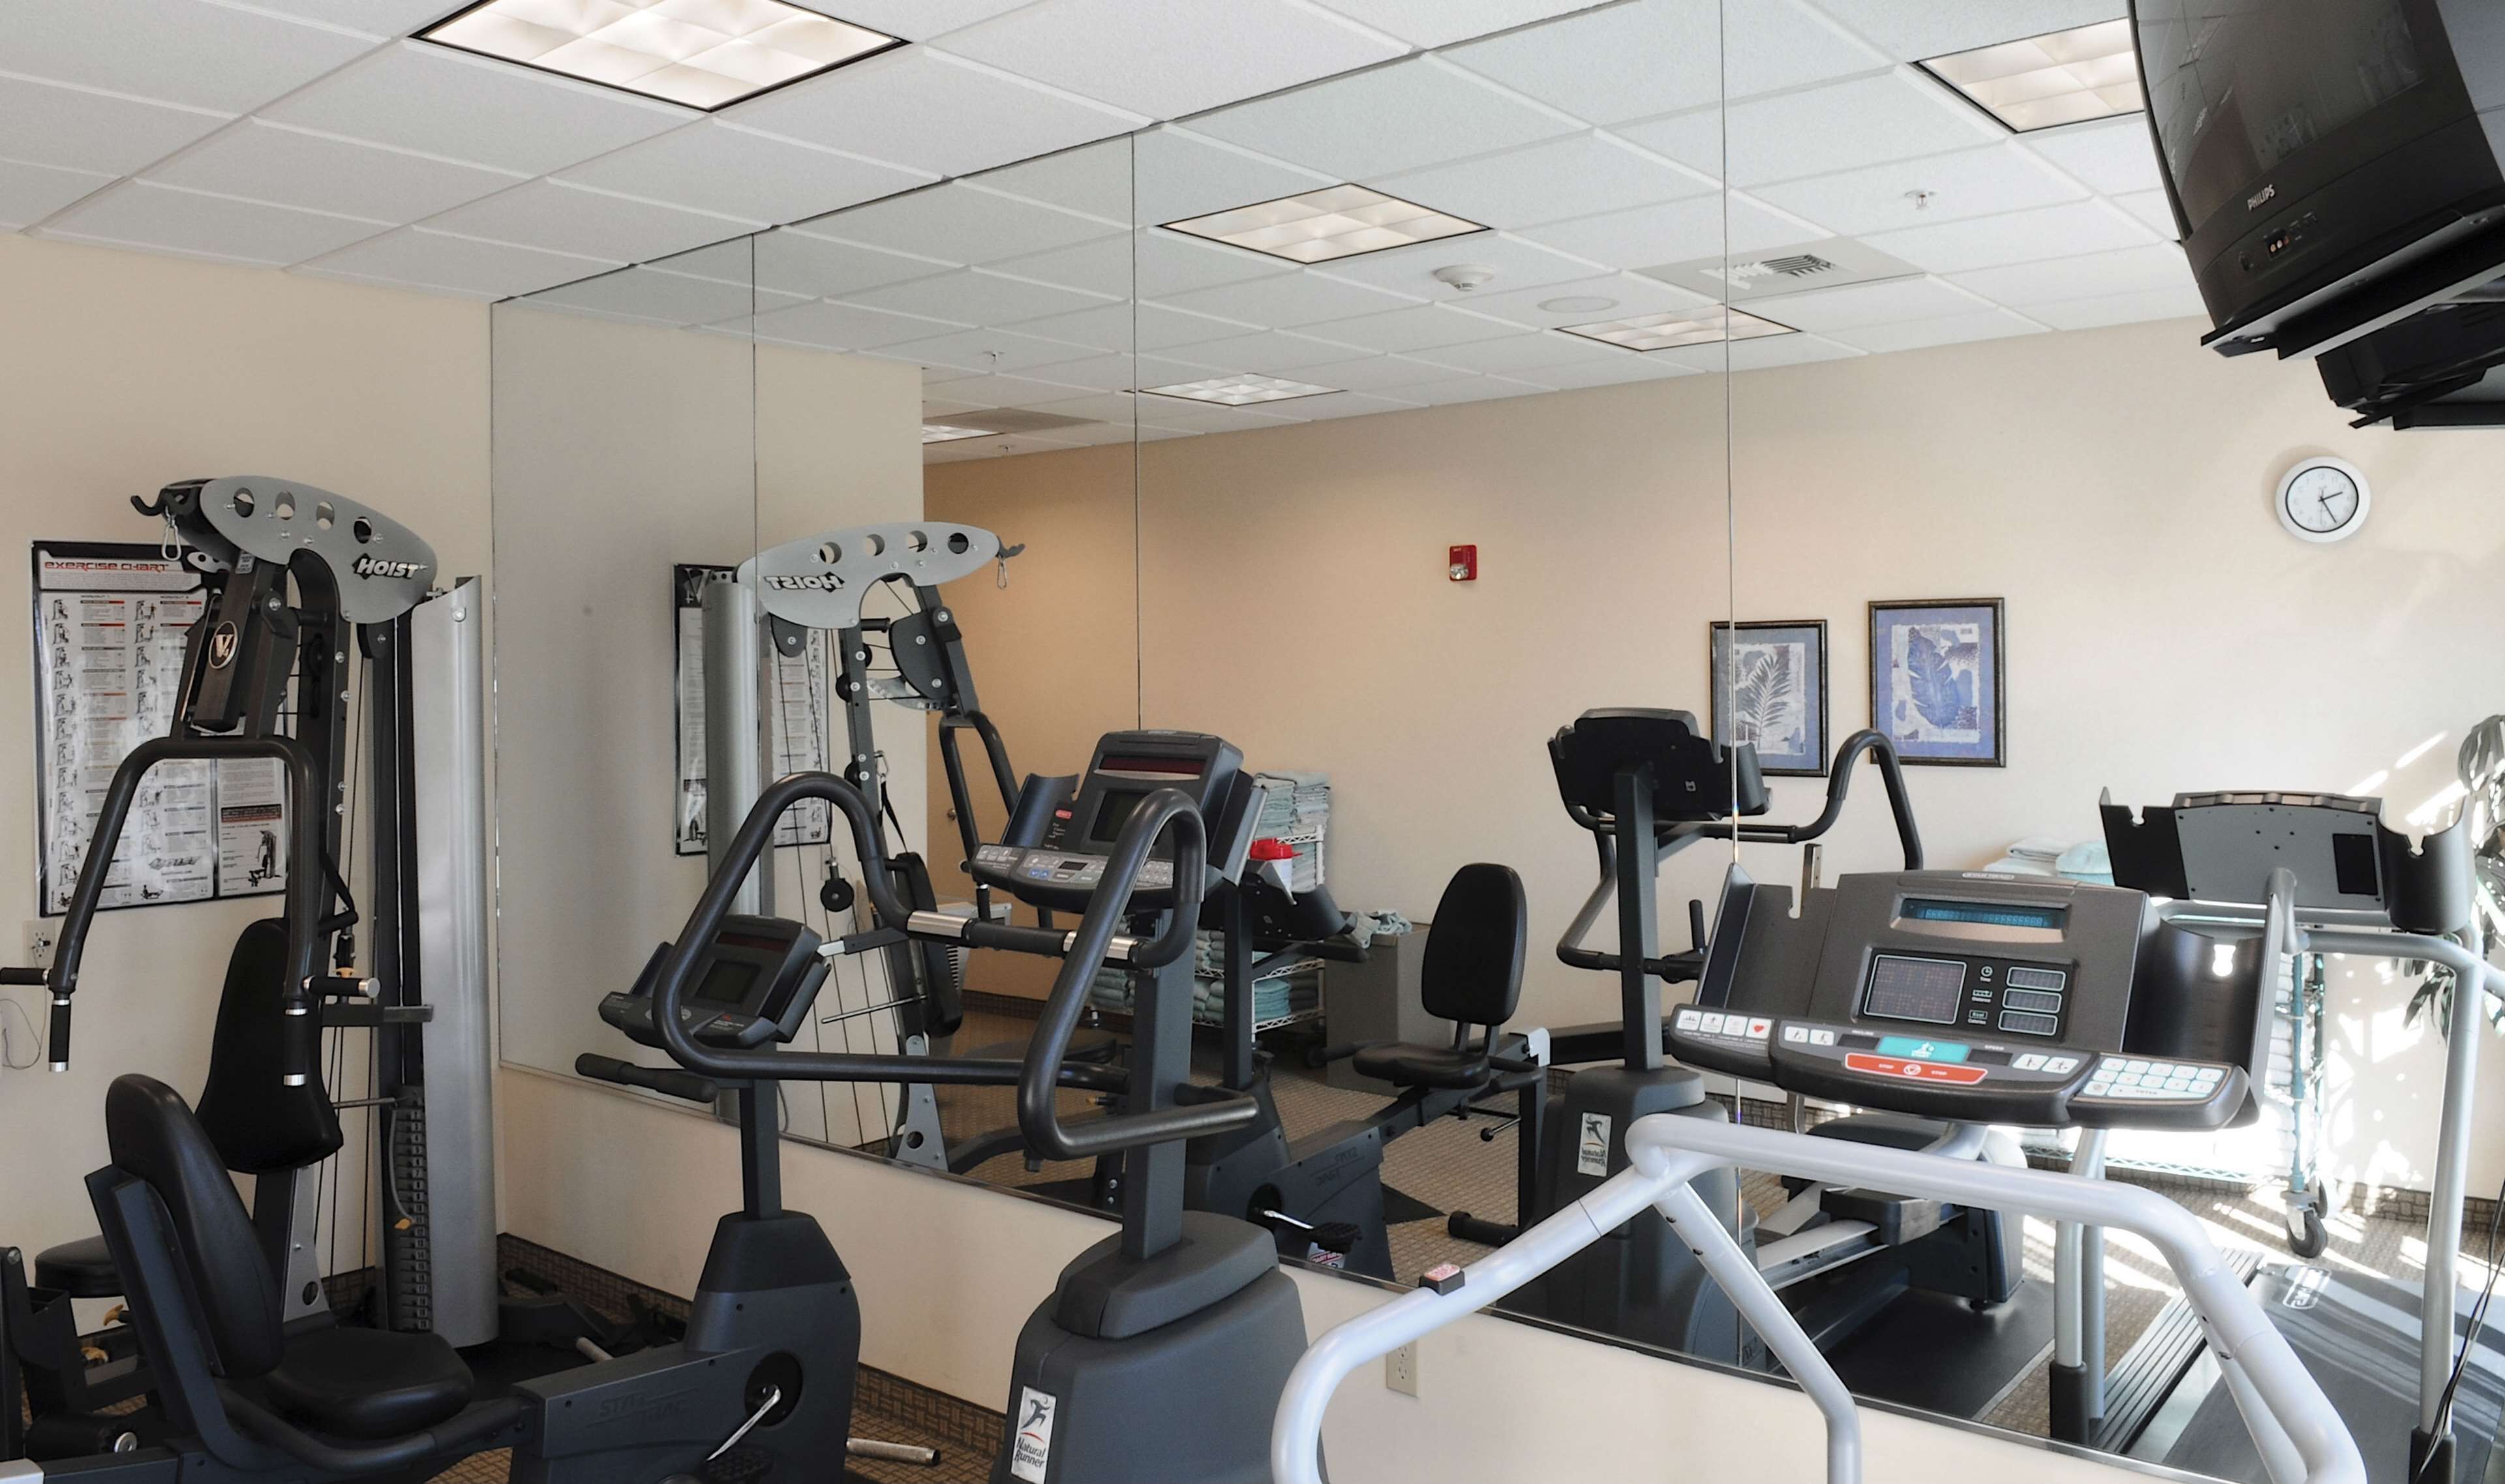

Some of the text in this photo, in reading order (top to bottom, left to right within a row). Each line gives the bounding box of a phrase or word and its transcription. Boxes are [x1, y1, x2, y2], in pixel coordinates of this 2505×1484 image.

[2247, 184, 2276, 211] PHILIPS
[356, 558, 419, 579] HOIST
[1016, 1437, 1046, 1458] Natural
[1014, 1449, 1045, 1468] Runner
